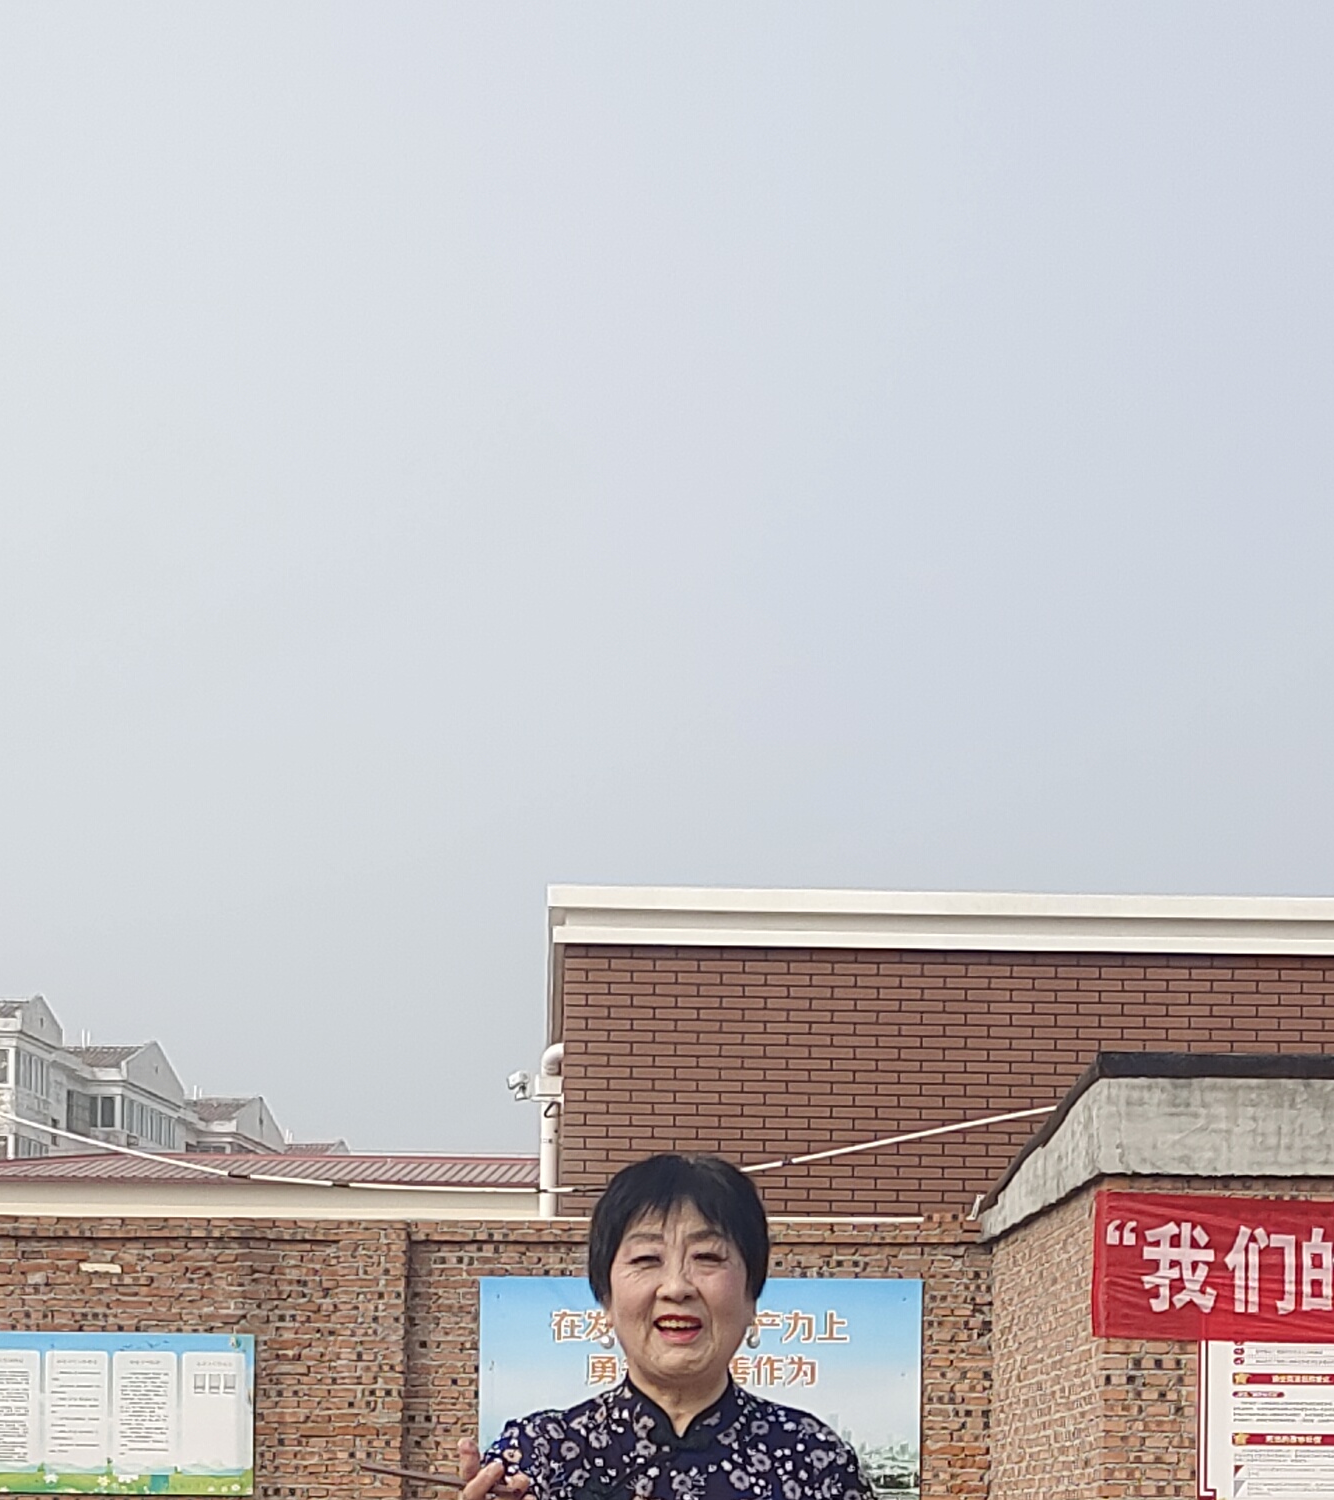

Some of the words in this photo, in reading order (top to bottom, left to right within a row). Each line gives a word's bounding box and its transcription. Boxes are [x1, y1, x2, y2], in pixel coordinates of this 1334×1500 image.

[551, 1309, 850, 1343] 在发产力上
